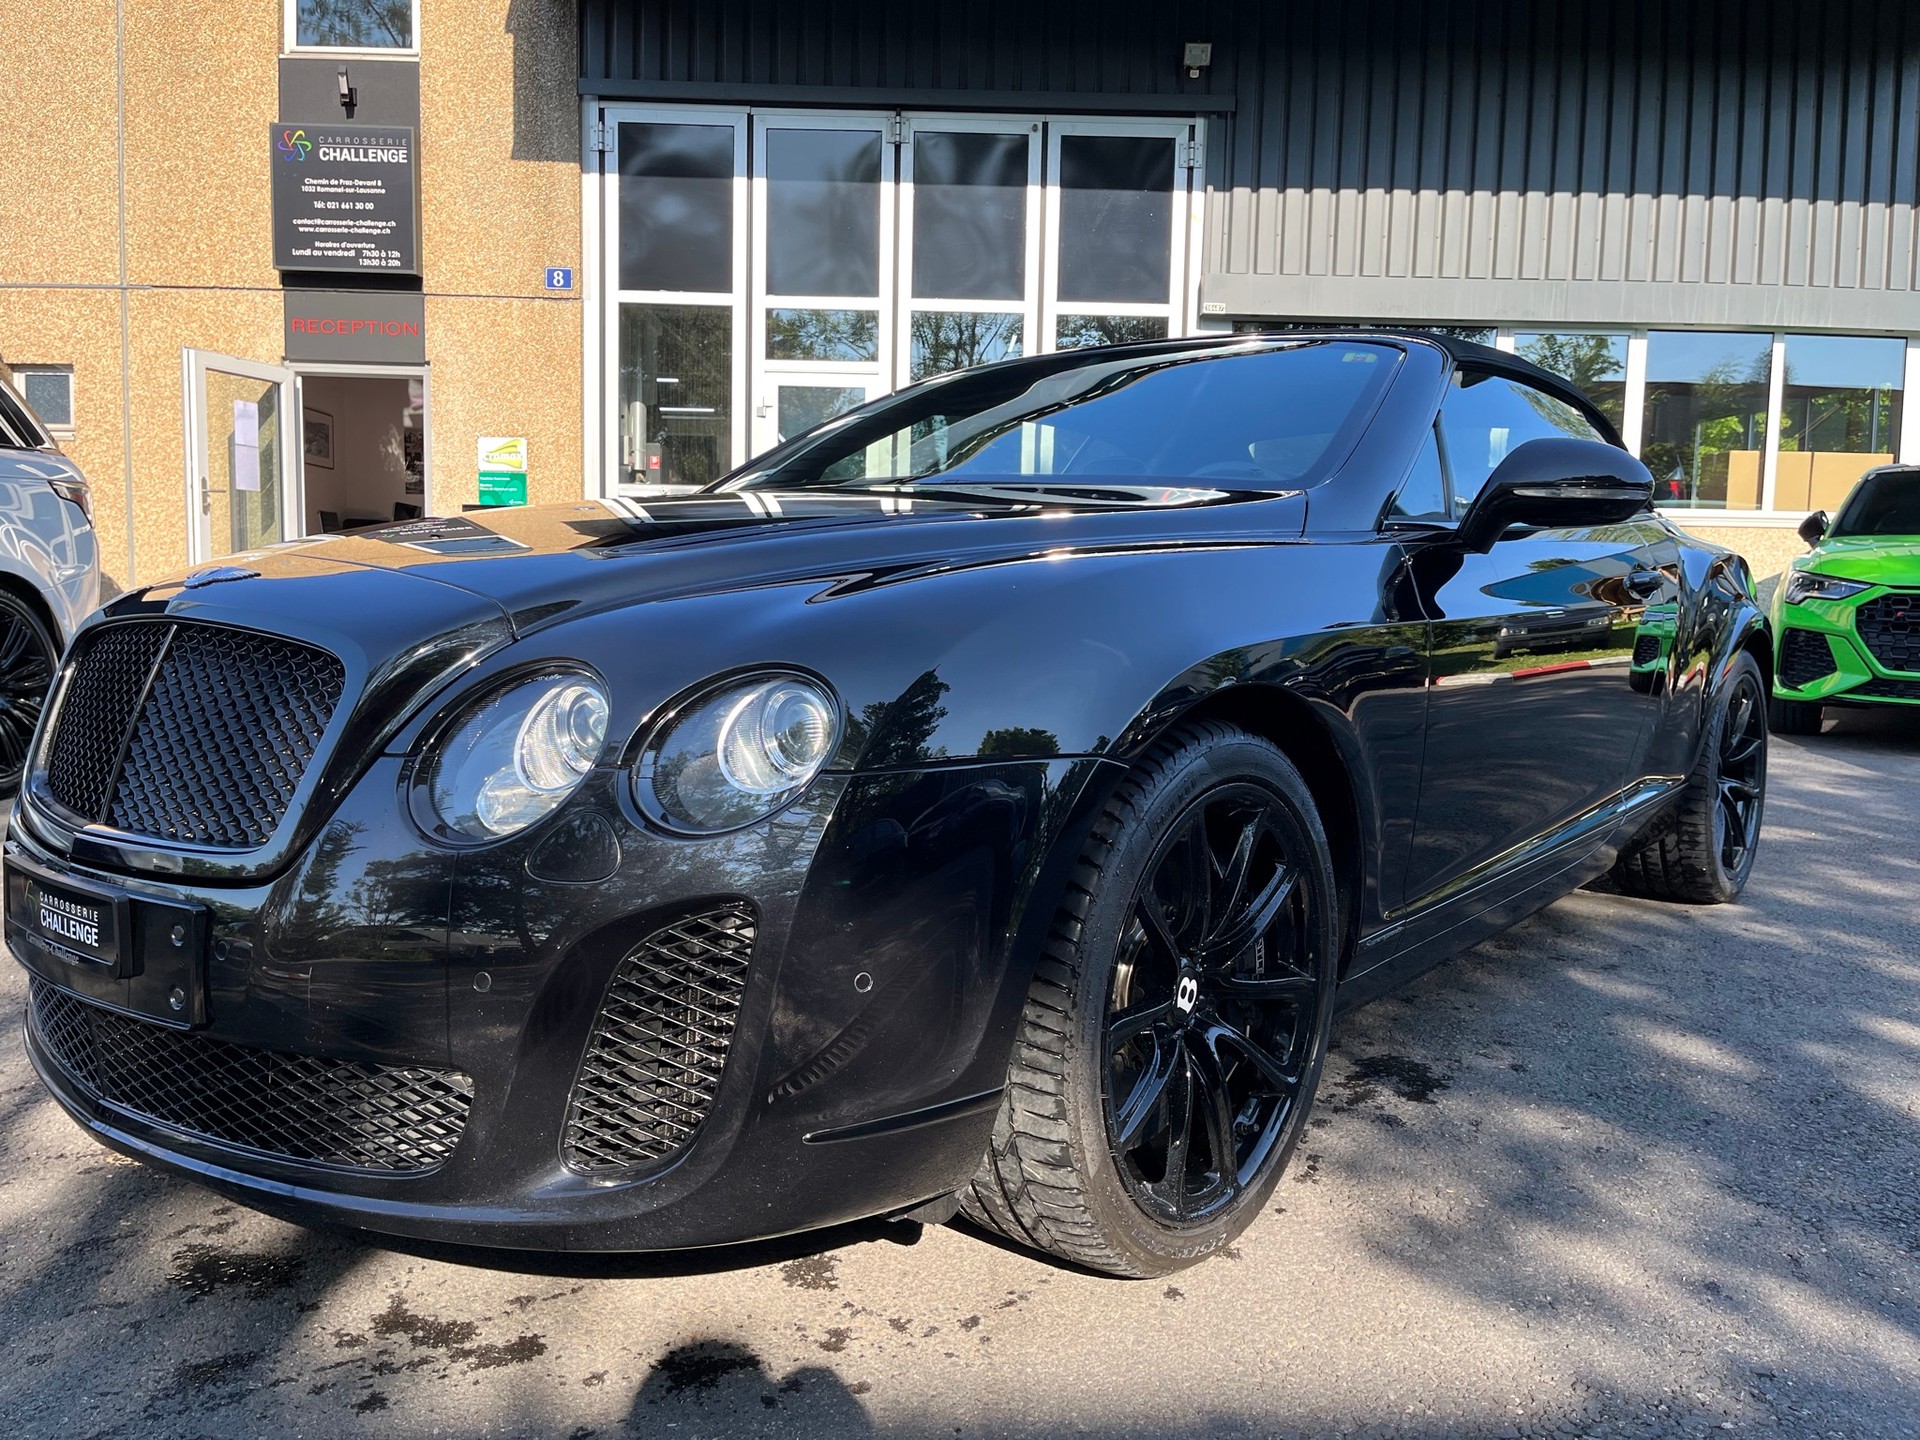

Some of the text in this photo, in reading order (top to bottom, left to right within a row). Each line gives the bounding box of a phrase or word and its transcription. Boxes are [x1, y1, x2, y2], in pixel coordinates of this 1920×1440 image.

[319, 136, 407, 146] CARROSSERIE
[319, 147, 408, 163] CHALLENGE
[304, 178, 329, 186] Chemin
[329, 178, 338, 186] de
[339, 179, 377, 187] Praz-Devant
[301, 185, 386, 194] 1032 Romanel-sur-Lausanne
[326, 201, 340, 209] 021
[341, 202, 354, 210] 661
[354, 202, 364, 210] 30
[364, 202, 374, 210] 00
[292, 218, 396, 227] contact@carrosserie-challenge.ch
[298, 226, 391, 235] www.carrosserie-challenge.ch
[314, 241, 340, 249] Horaires
[292, 248, 401, 258] Lundi au vendredi 7h30 à 12h
[358, 258, 401, 267] 13h30 à 20h
[553, 270, 565, 287] 8
[291, 317, 419, 337] RECEPTION
[39, 891, 99, 922] CARROSSERIE
[40, 908, 99, 947] CHALLENGE
[1177, 976, 1198, 1014] B
